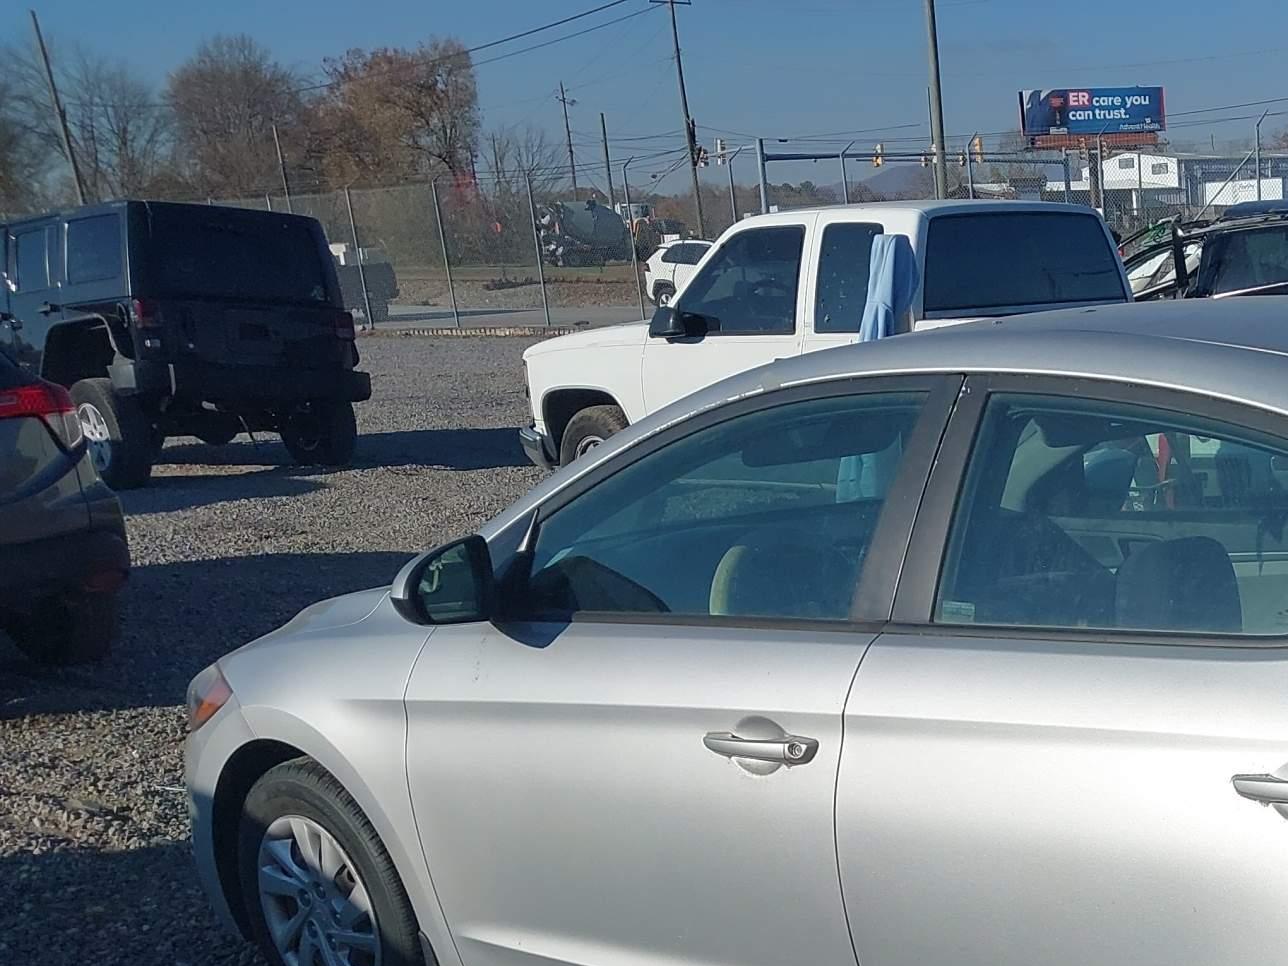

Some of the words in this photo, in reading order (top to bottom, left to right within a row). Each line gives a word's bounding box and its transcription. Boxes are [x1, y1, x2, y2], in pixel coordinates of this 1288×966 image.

[1069, 92, 1089, 106] ER
[1093, 96, 1121, 107] care
[1125, 95, 1149, 108] you
[1069, 110, 1093, 121] can
[1095, 108, 1129, 120] trust.
